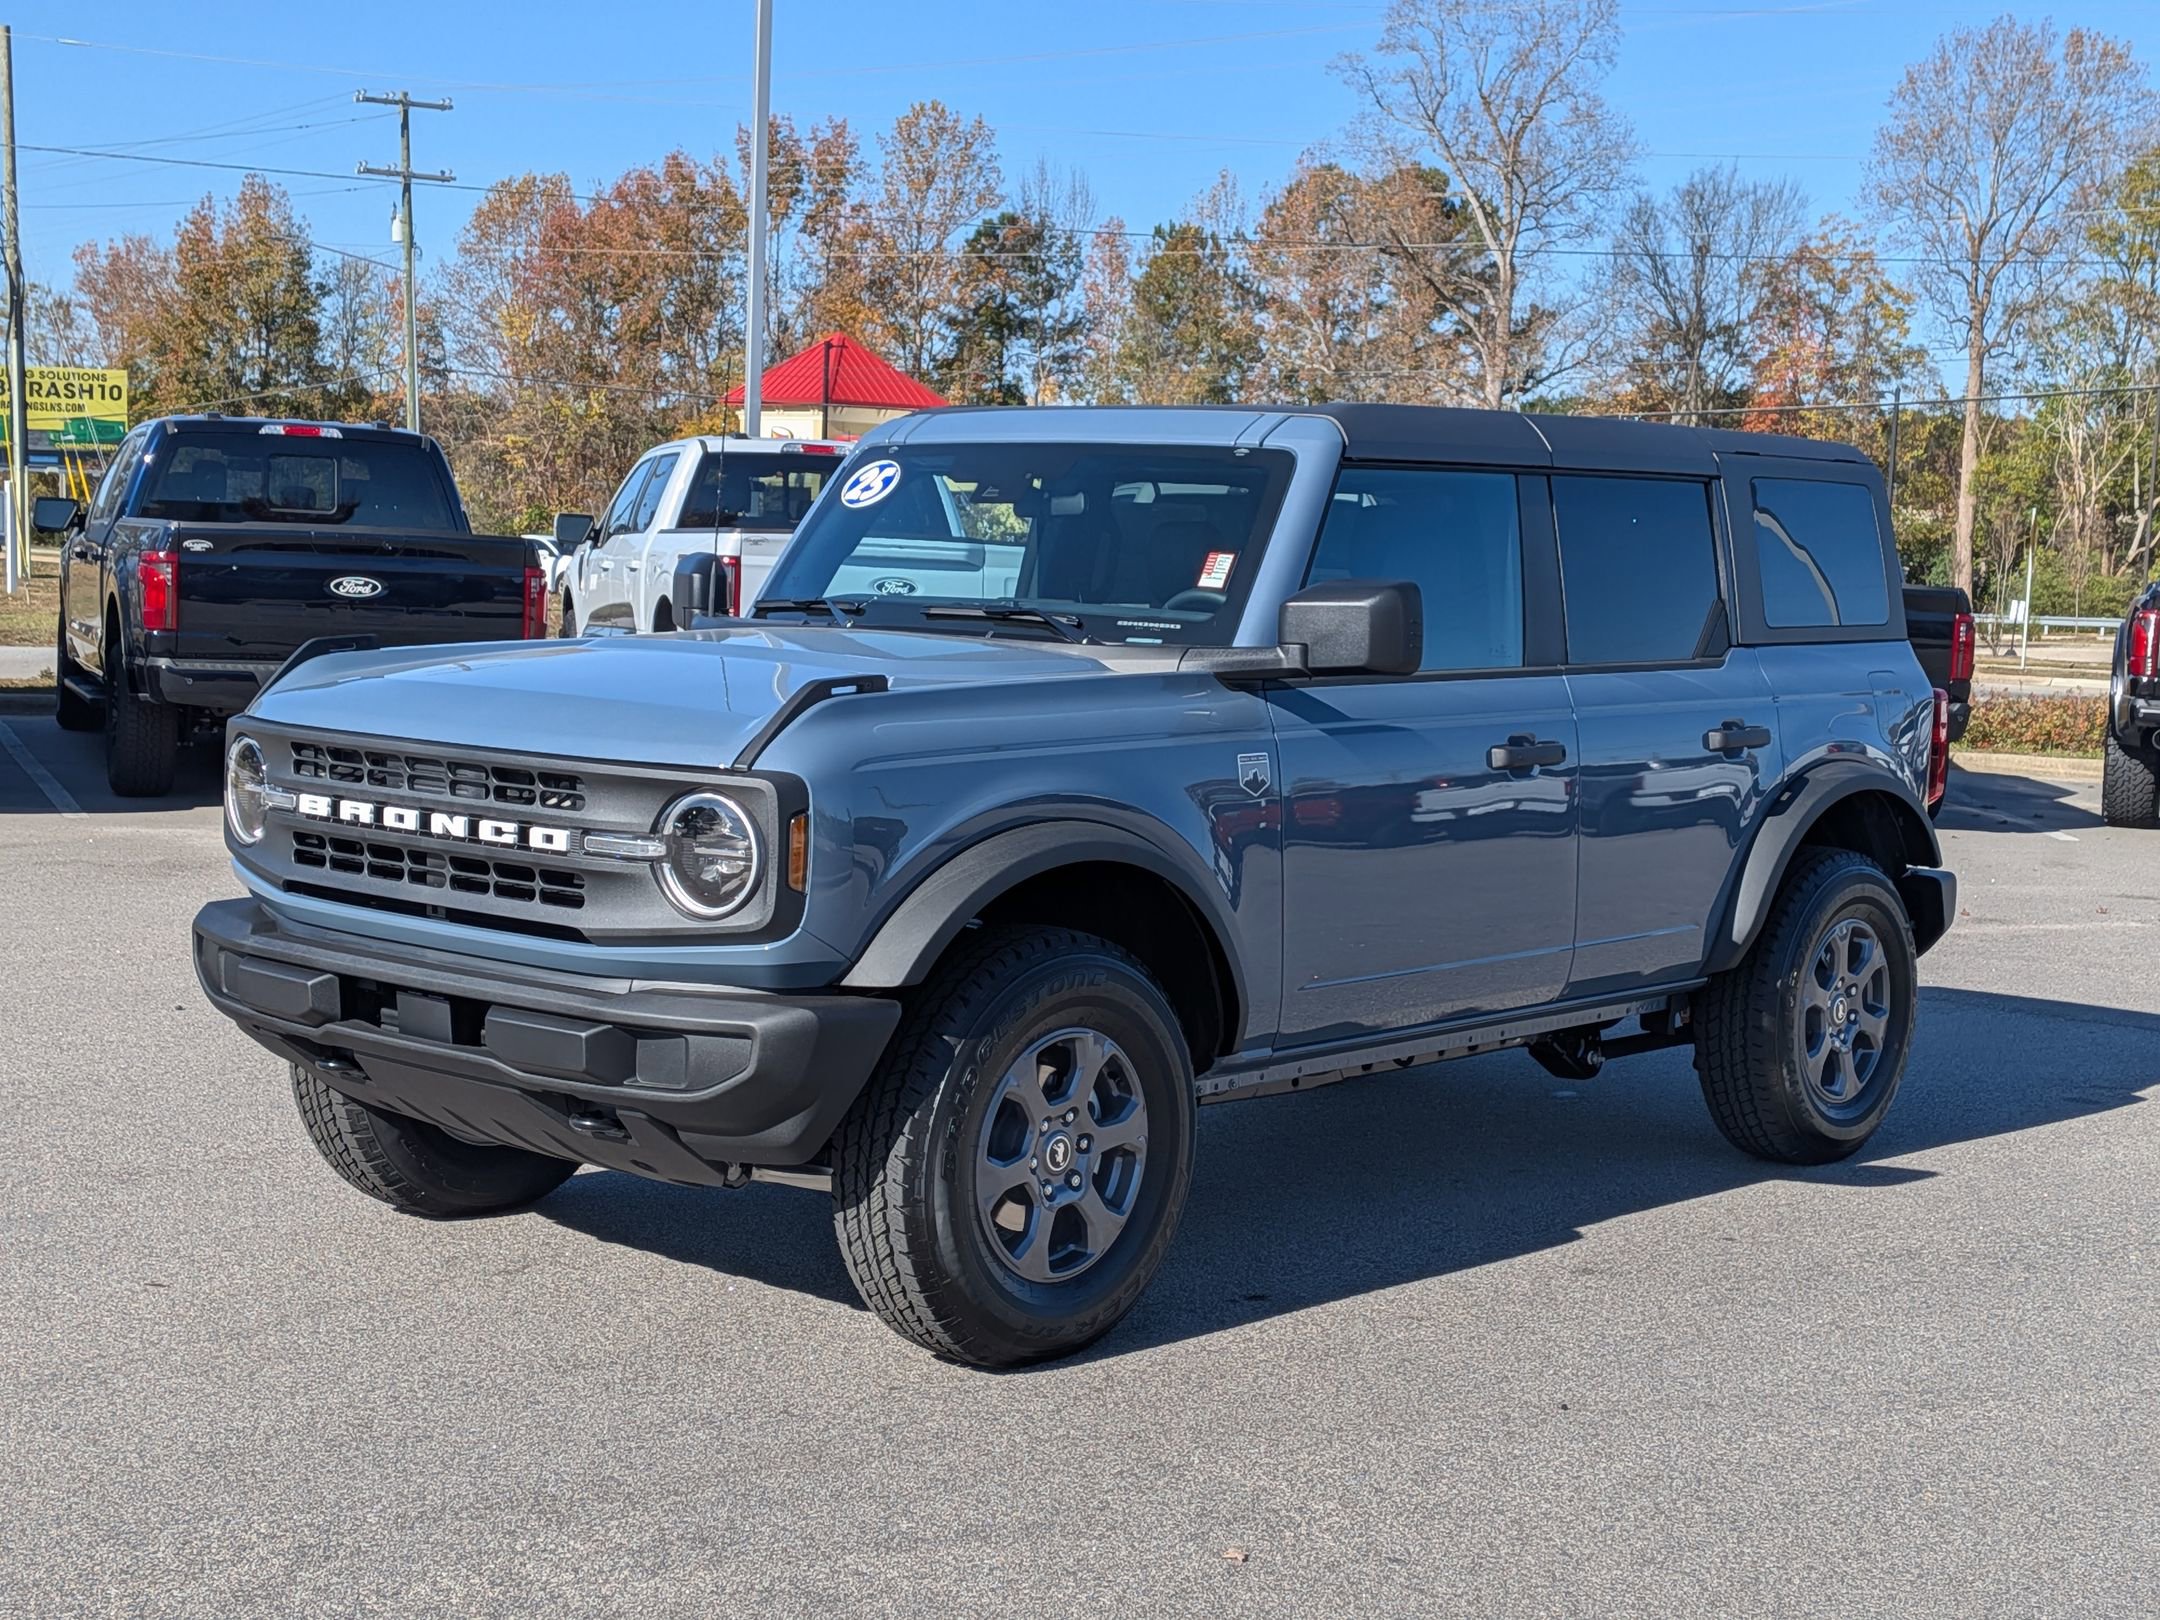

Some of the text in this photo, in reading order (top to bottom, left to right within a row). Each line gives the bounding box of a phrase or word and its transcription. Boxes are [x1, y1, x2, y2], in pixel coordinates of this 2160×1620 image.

[39, 370, 108, 382] SOLUTIONS
[29, 381, 123, 401] RASH10
[844, 466, 898, 501] 25
[299, 793, 571, 852] BRONCO
